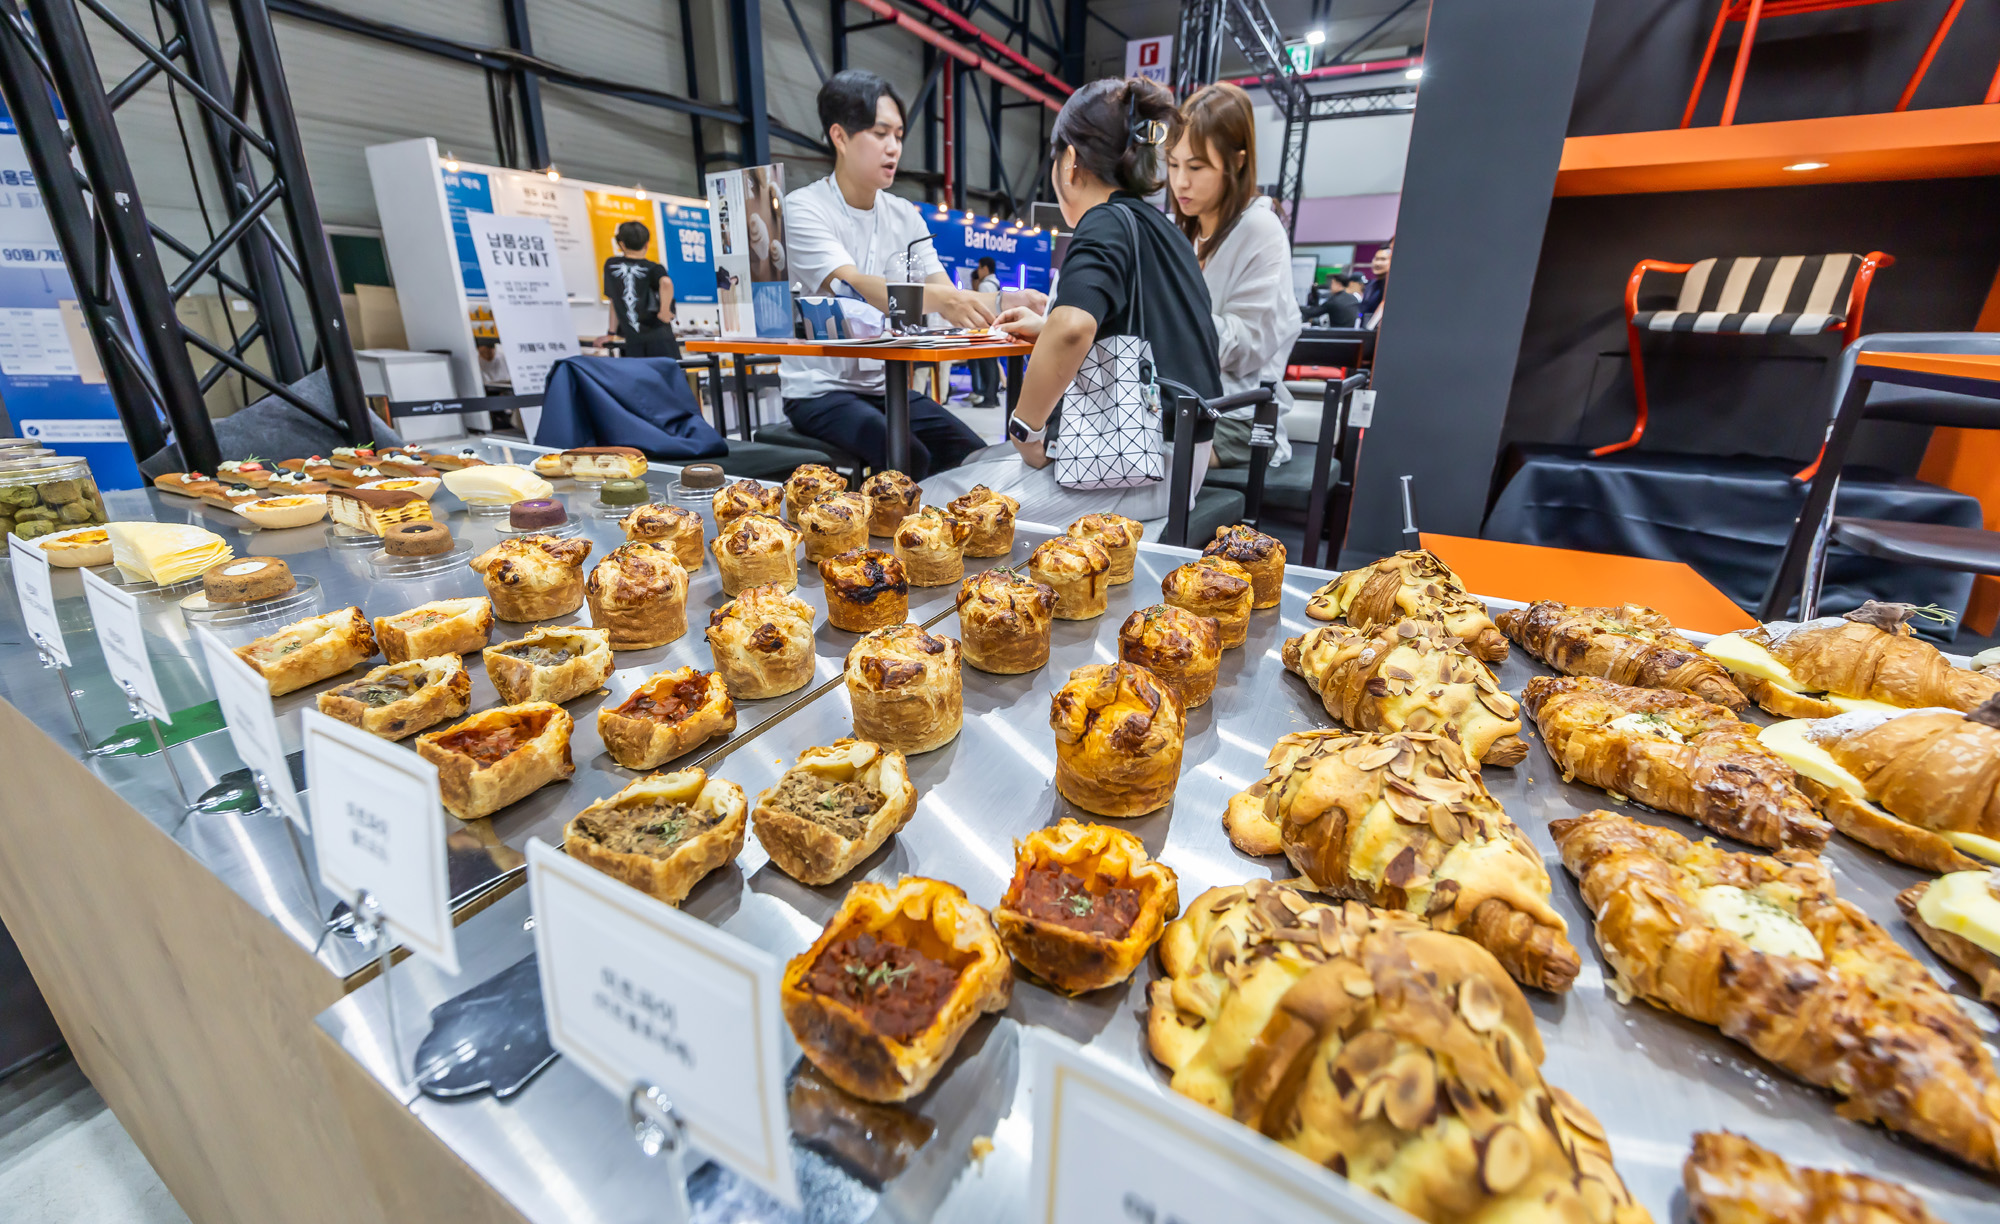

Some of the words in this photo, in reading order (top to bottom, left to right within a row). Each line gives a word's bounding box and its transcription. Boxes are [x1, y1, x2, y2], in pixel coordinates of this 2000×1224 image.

[486, 232, 545, 251] 납품상담
[964, 226, 1018, 253] Bartooler
[492, 250, 550, 267] EVENT
